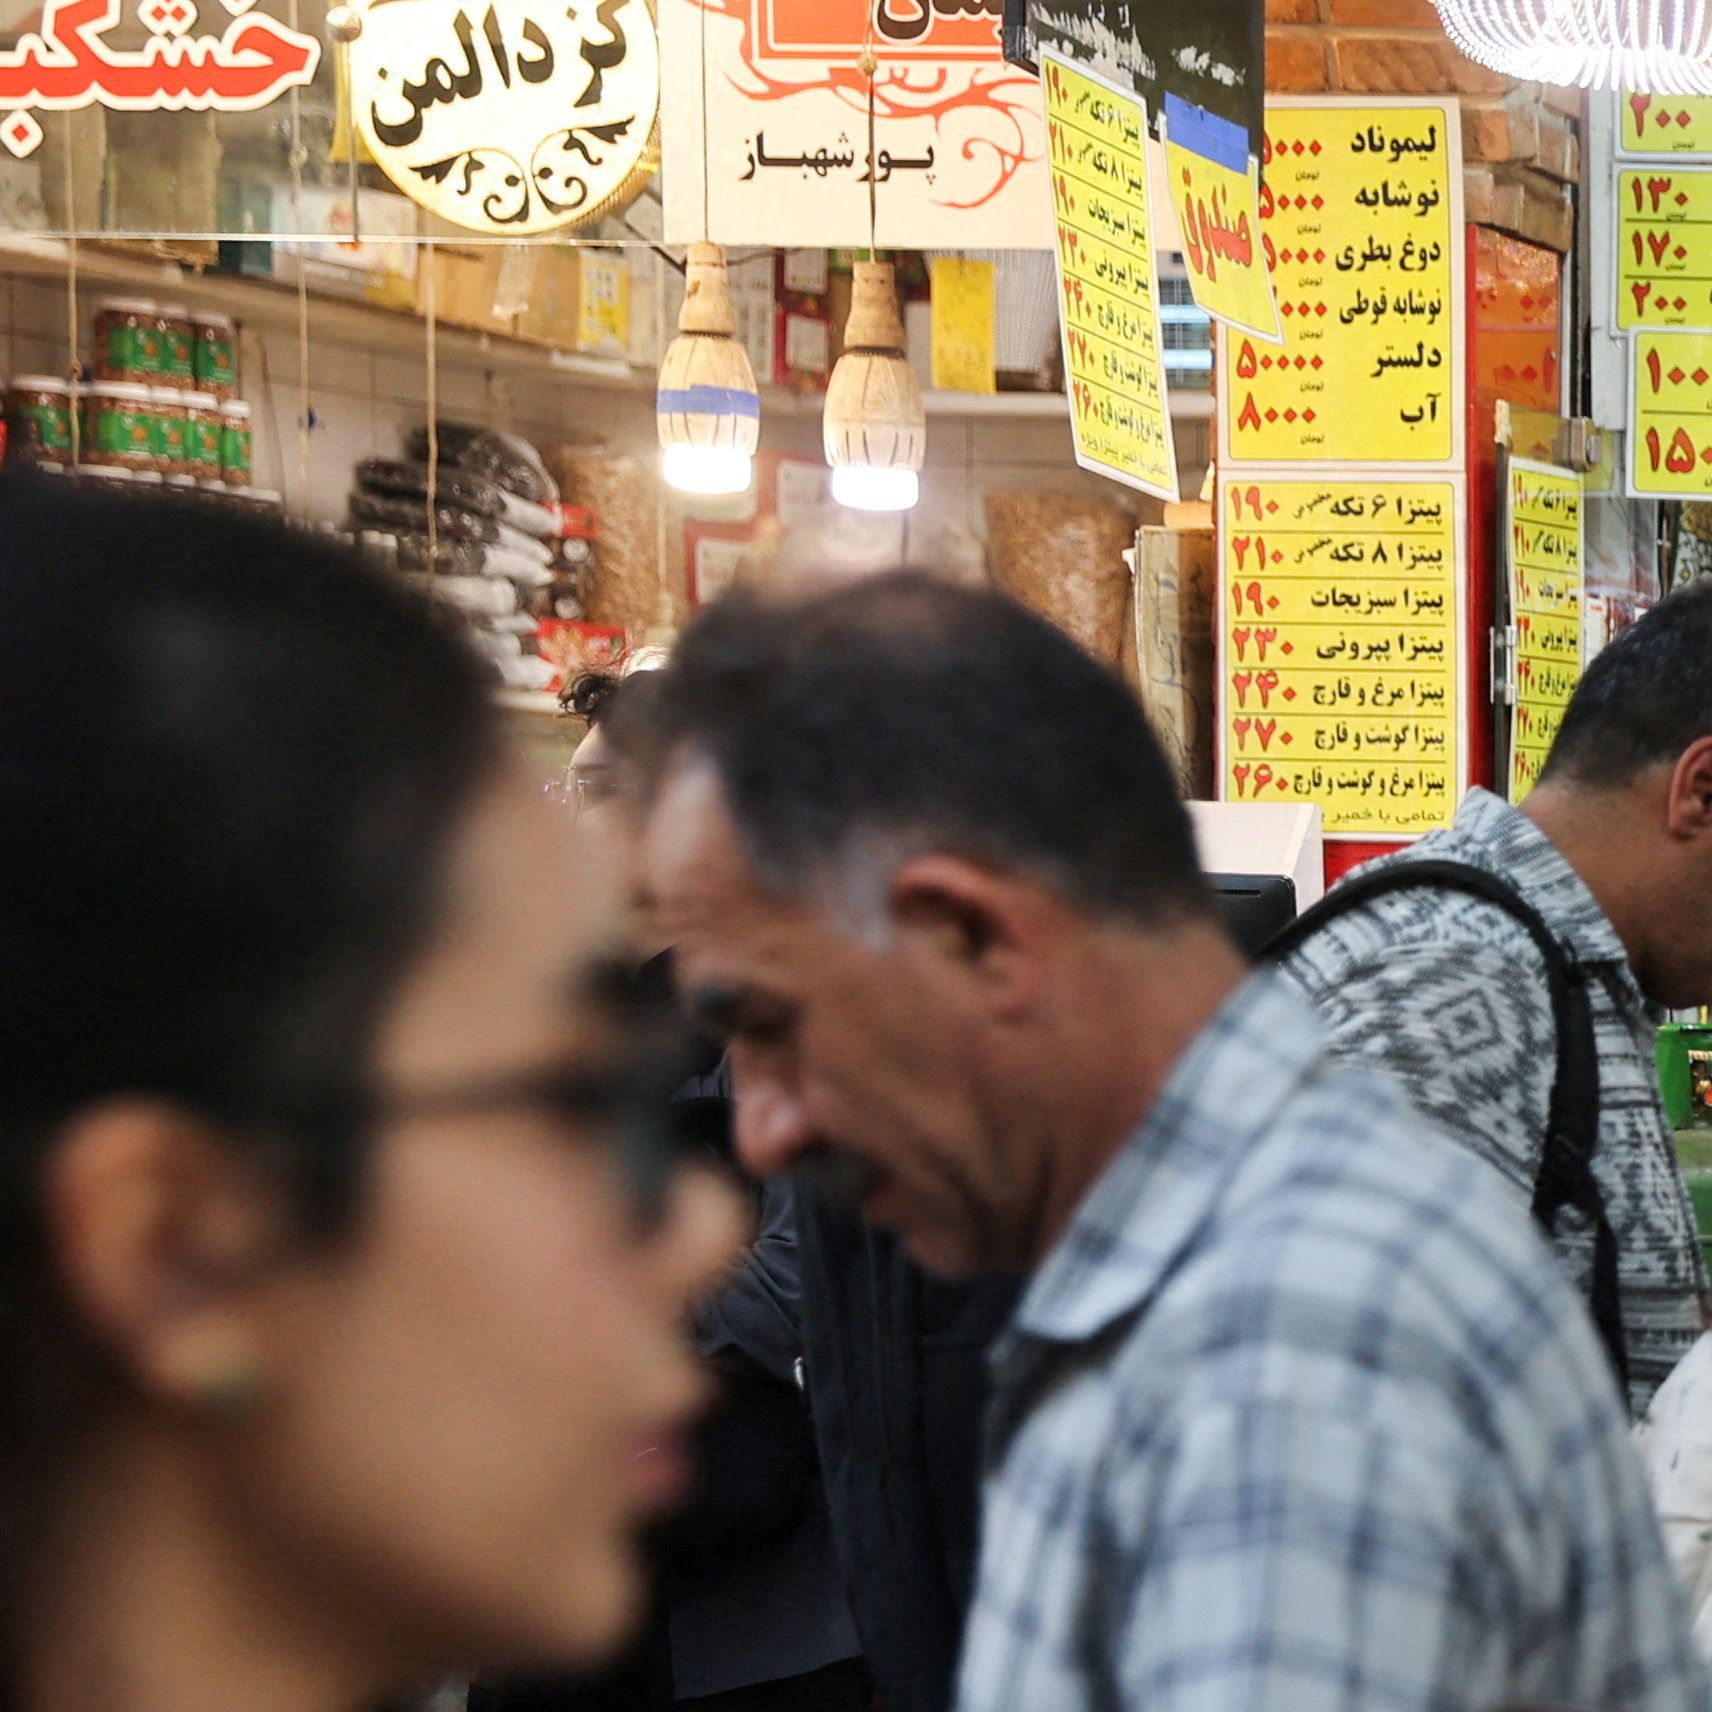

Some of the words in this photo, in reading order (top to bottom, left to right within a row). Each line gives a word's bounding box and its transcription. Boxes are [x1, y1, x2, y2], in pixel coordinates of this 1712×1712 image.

[1351, 126, 1437, 162] لیموناد
[1355, 180, 1440, 216] نوشابه
[1181, 165, 1253, 283] صندوق
[1335, 236, 1392, 271] بطری
[1399, 238, 1441, 270] دوغ
[1339, 287, 1387, 324] قوطی
[1393, 289, 1442, 324] نوشابه
[1237, 339, 1324, 378] ۵۰۰۰۰
[1371, 342, 1442, 377] دلستر
[1646, 348, 1710, 394] ۱۰۰
[1238, 392, 1317, 432] ۸۰۰۰
[1399, 393, 1441, 430] آب
[1231, 486, 1279, 521] ۱۹۰
[1330, 497, 1364, 516] تکه
[1371, 495, 1387, 519] ۶
[1396, 498, 1442, 526] پیتزا
[1232, 582, 1280, 616] ۱۹۰
[1311, 587, 1396, 615] سبزیجات
[1404, 588, 1443, 616] پیتزا
[1232, 628, 1294, 662] ۲۳۰
[1399, 634, 1444, 661] پیتزا
